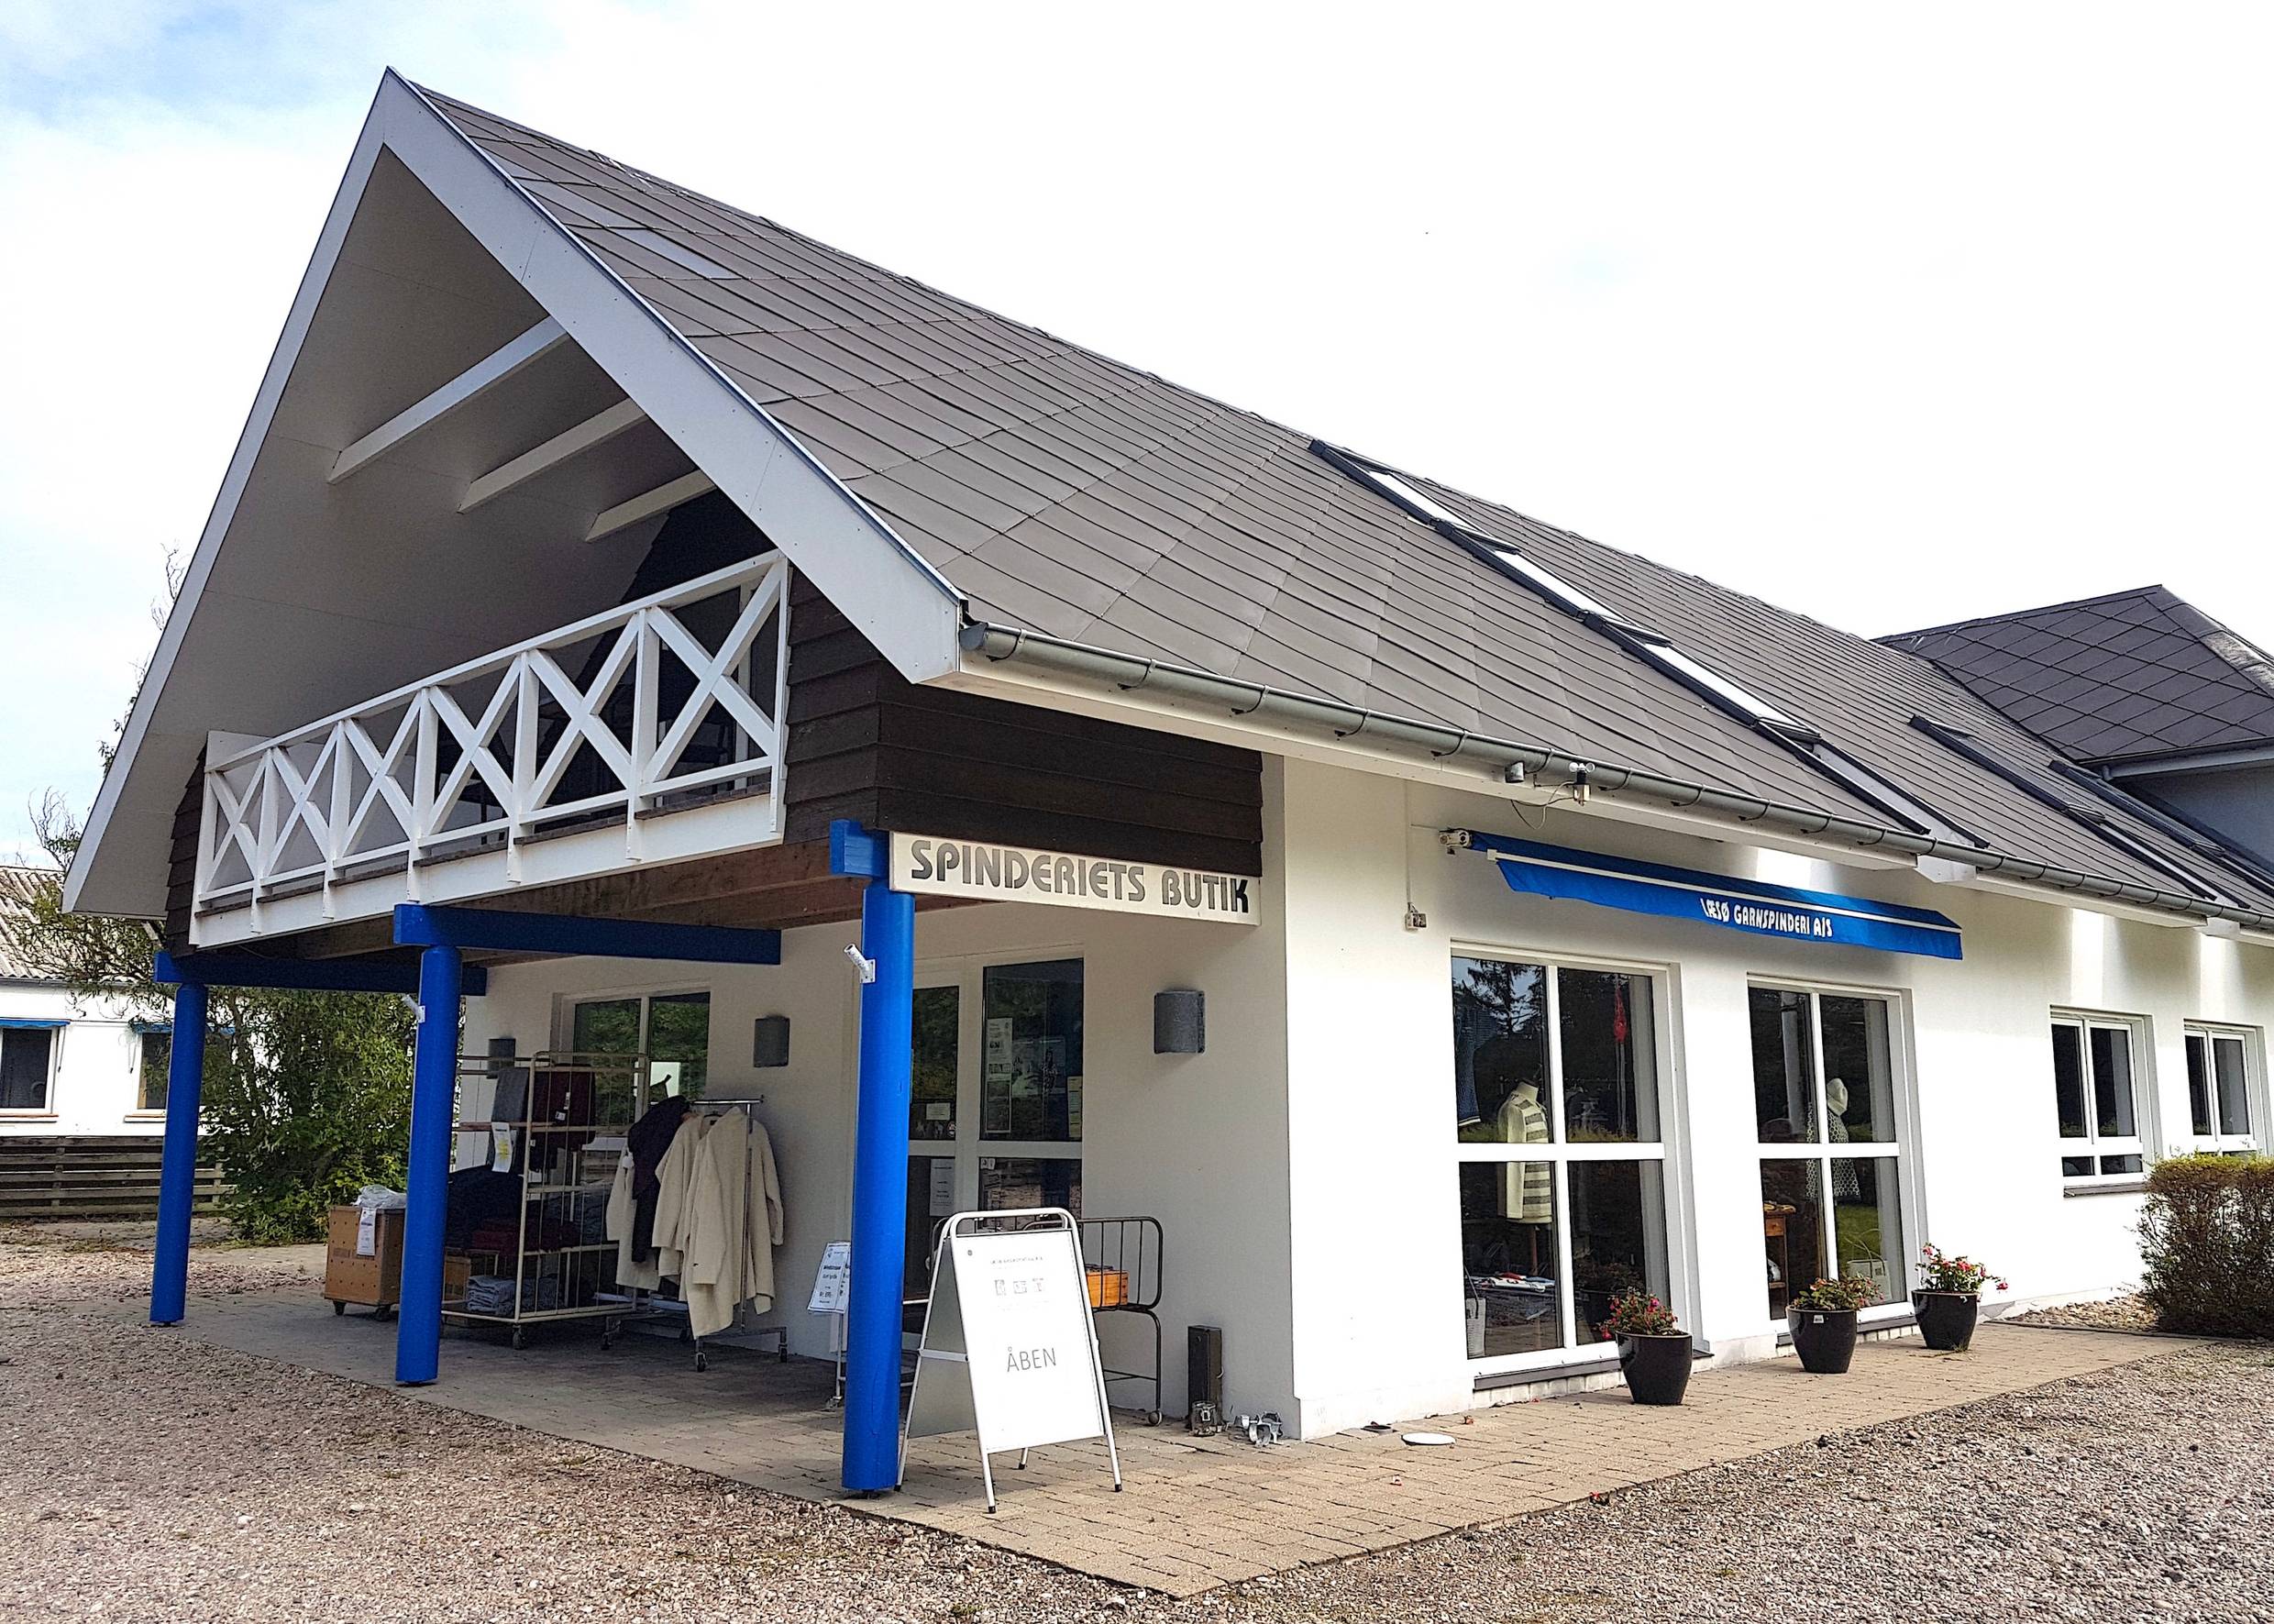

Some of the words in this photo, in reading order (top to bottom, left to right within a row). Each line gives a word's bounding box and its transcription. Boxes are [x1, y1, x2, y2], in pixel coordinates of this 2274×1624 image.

[911, 839, 1145, 901] SPINDERIETS
[1162, 869, 1249, 913] BUTIK
[1700, 898, 1730, 922] LÆSØ
[1733, 904, 1810, 935] GARNSPINDERI
[1813, 917, 1833, 937] A/S
[1007, 1346, 1056, 1372] ÅBEN
